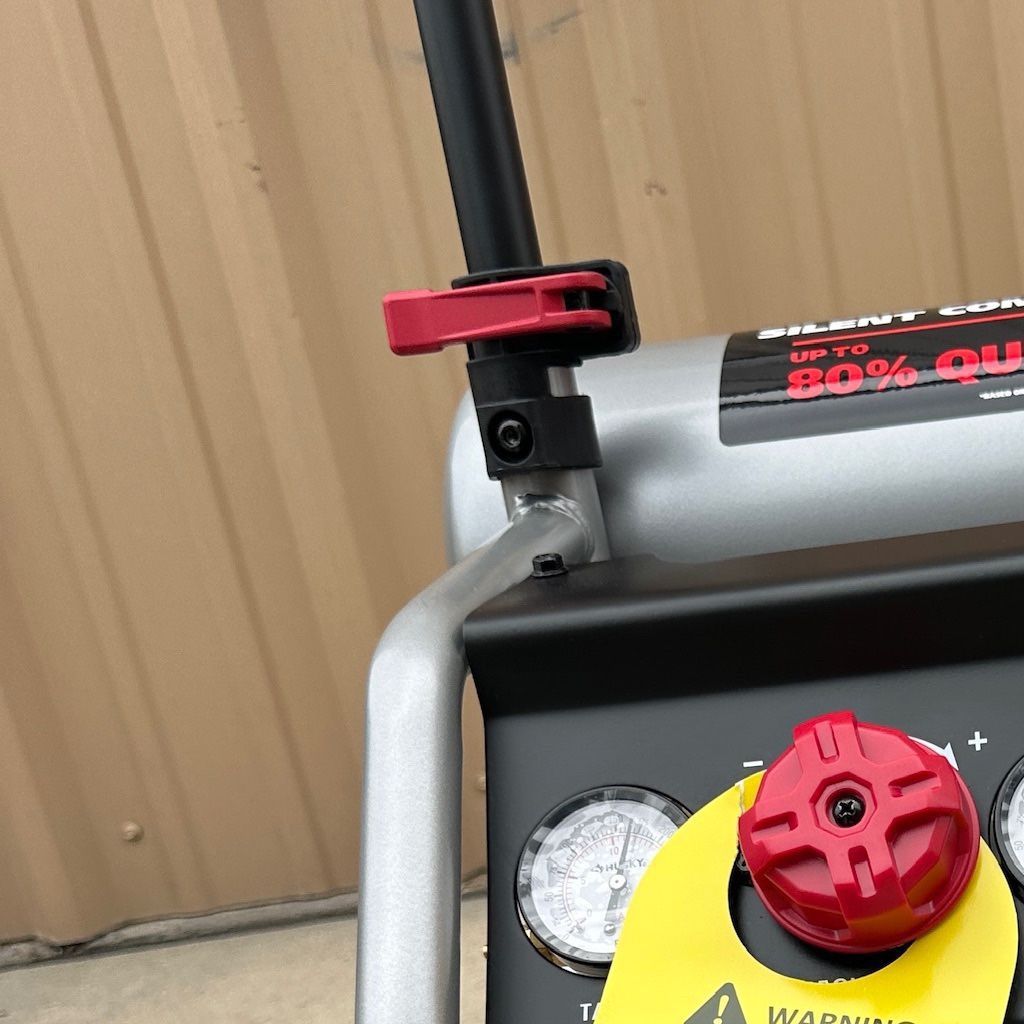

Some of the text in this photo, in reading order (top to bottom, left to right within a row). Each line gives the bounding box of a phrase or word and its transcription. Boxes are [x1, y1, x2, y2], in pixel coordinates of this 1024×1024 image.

[756, 310, 927, 340] SILENT
[789, 343, 869, 363] UP TO
[786, 355, 918, 400] 80%
